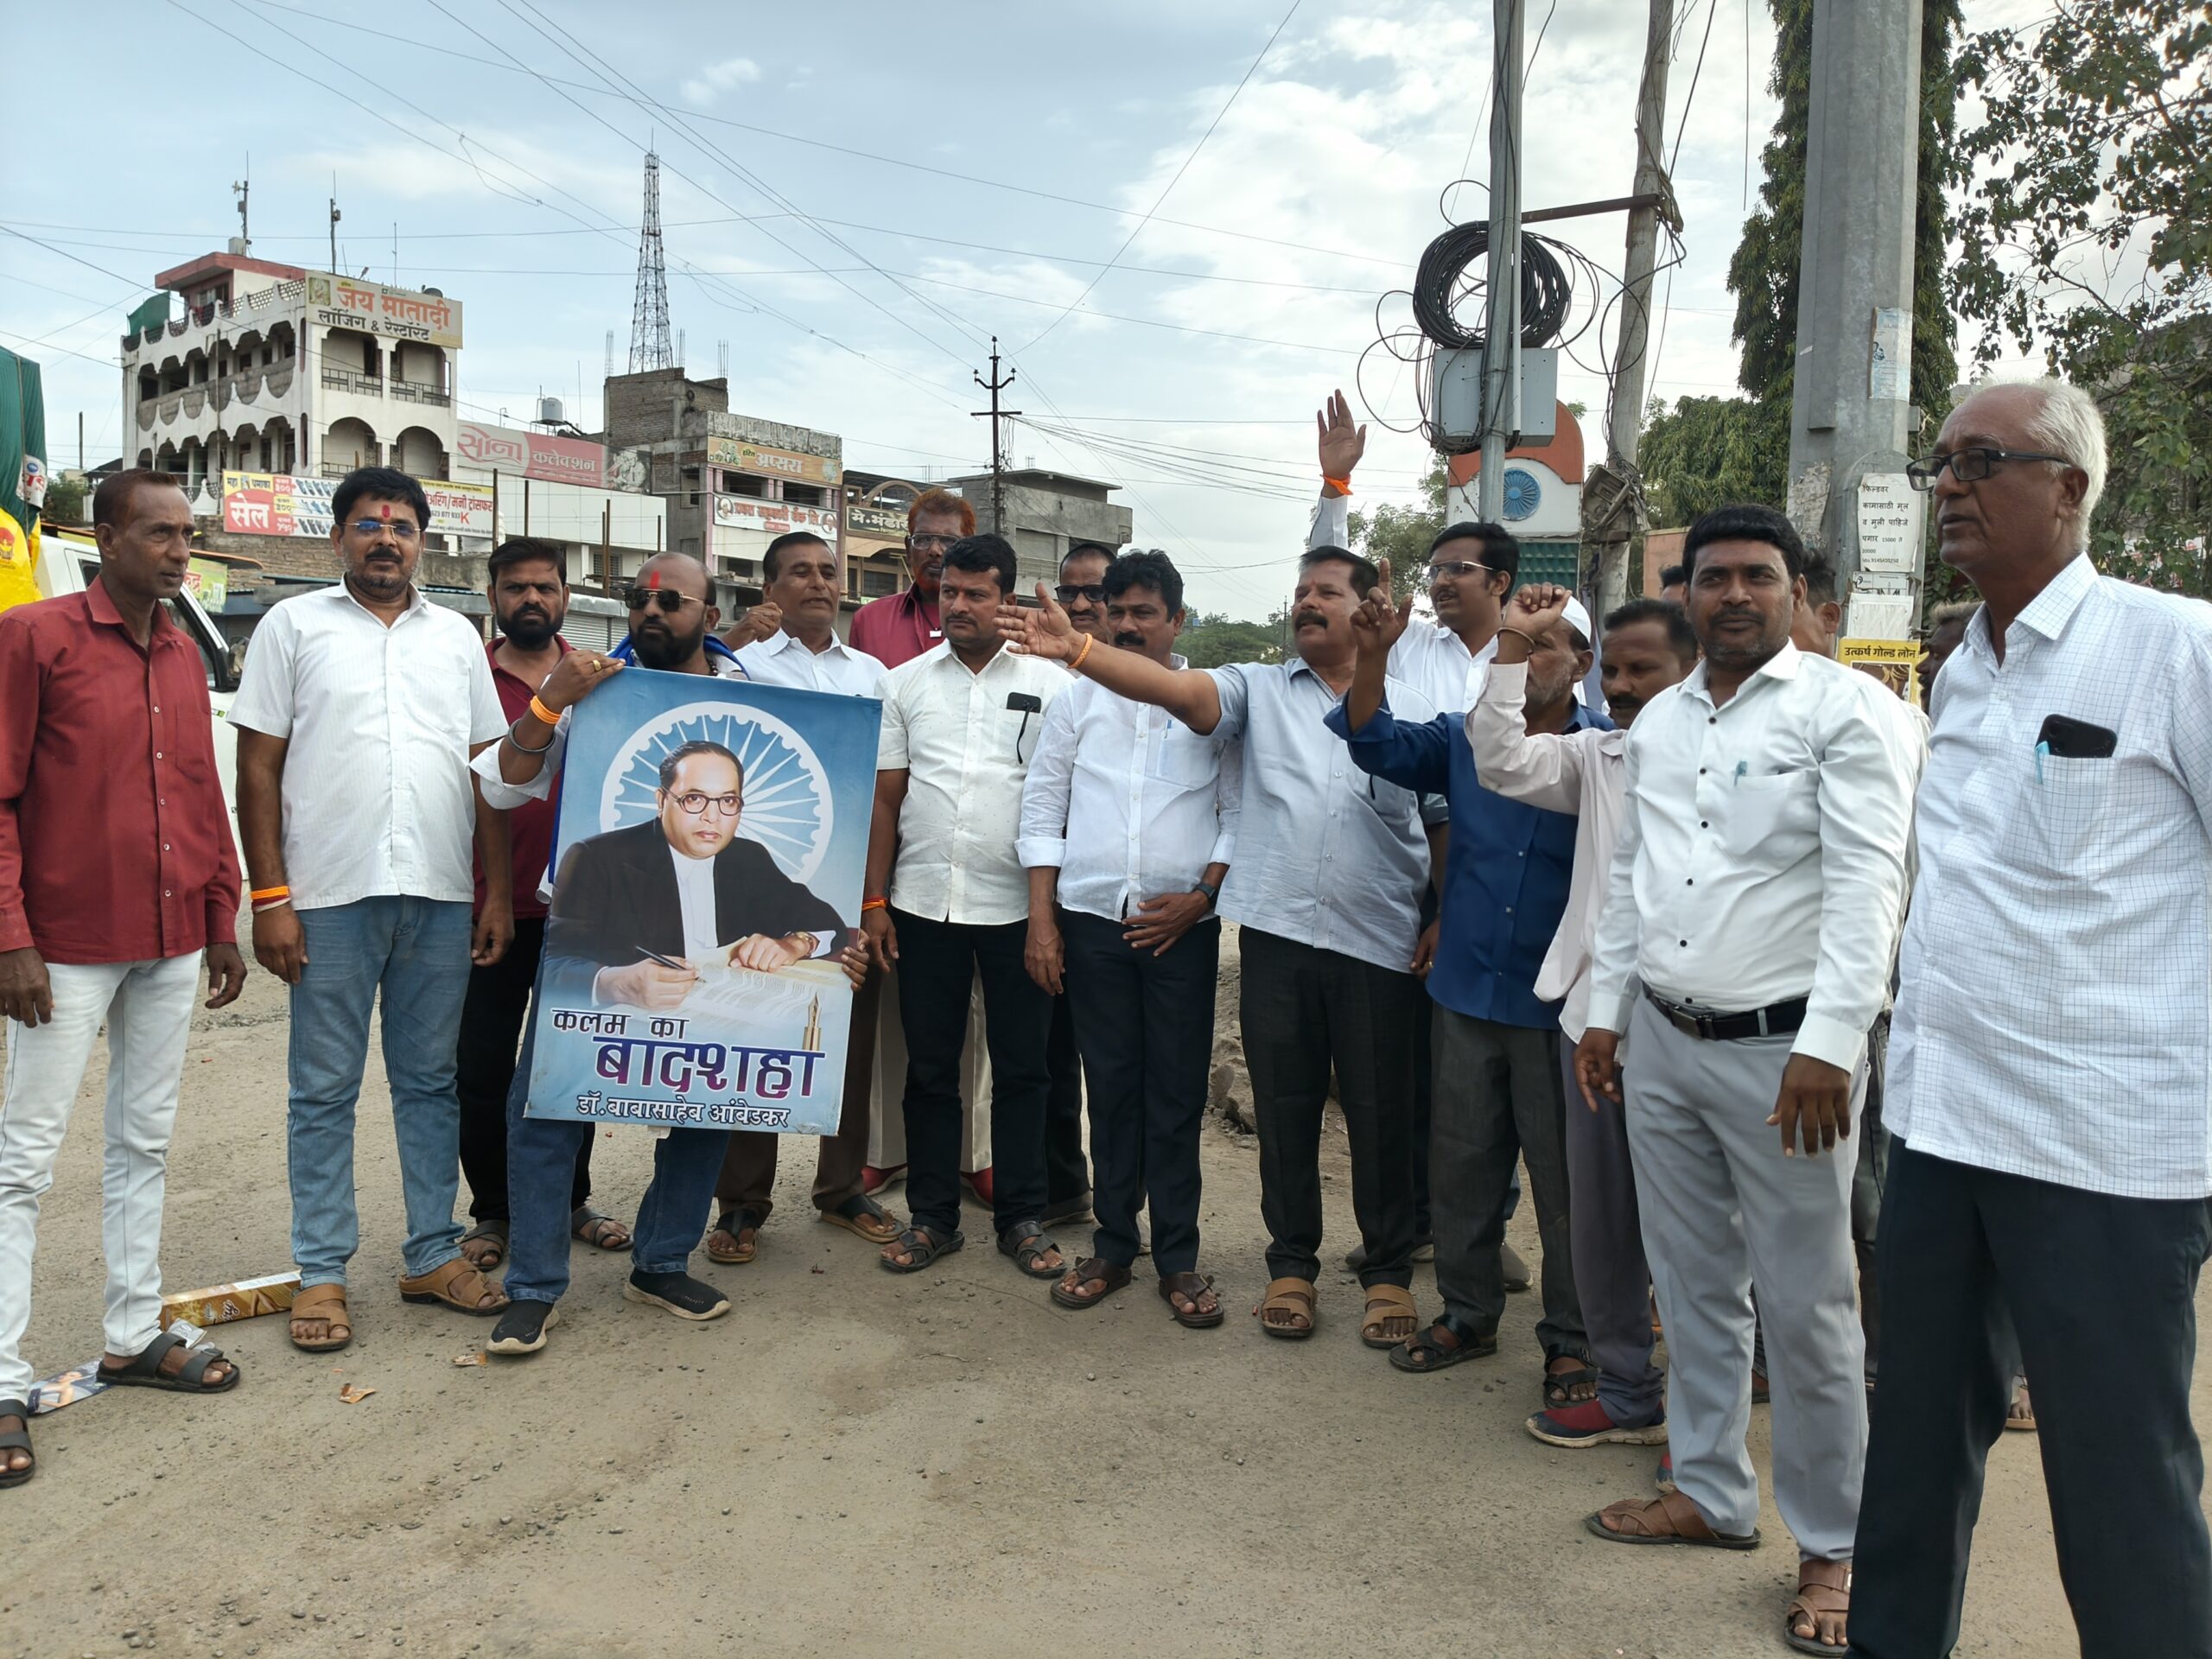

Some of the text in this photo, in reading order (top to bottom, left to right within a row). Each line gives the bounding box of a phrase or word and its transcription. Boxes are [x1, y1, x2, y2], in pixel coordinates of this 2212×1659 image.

[318, 308, 366, 328] लॉजिंग
[371, 320, 380, 332] &
[337, 287, 451, 330] जय मातादी
[457, 425, 523, 464] सोना
[229, 492, 270, 530] सेल
[1844, 645, 1916, 658] उत्कर्ष गोल्ड लोन
[551, 1009, 690, 1040] कलम का
[591, 1035, 827, 1100] बादशहा
[708, 1097, 791, 1128] आंबेडकर
